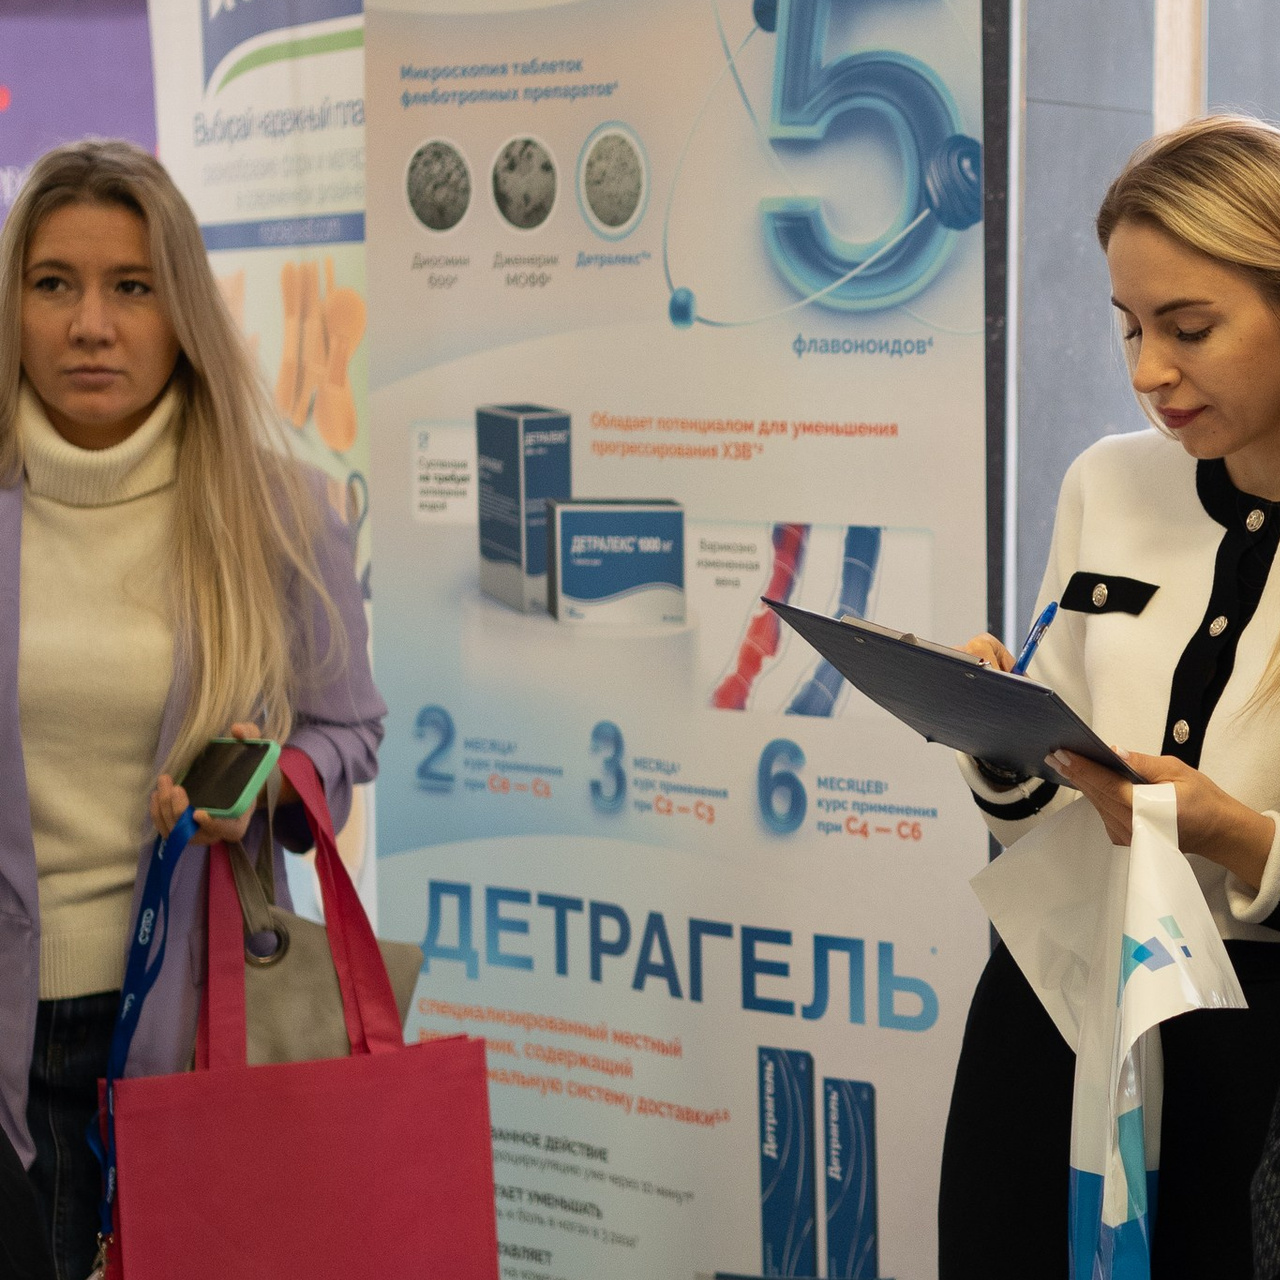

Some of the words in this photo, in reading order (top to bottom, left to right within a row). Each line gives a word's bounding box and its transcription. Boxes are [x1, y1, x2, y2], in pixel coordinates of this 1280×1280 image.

[758, 420, 787, 437] для
[793, 422, 899, 440] уменьшения
[415, 704, 455, 784] 2
[590, 720, 627, 810] 3
[757, 737, 808, 834] 6
[418, 996, 608, 1042] специализированный
[612, 1028, 683, 1059] местный
[524, 1041, 634, 1079] содержащий
[566, 1080, 635, 1114] систему
